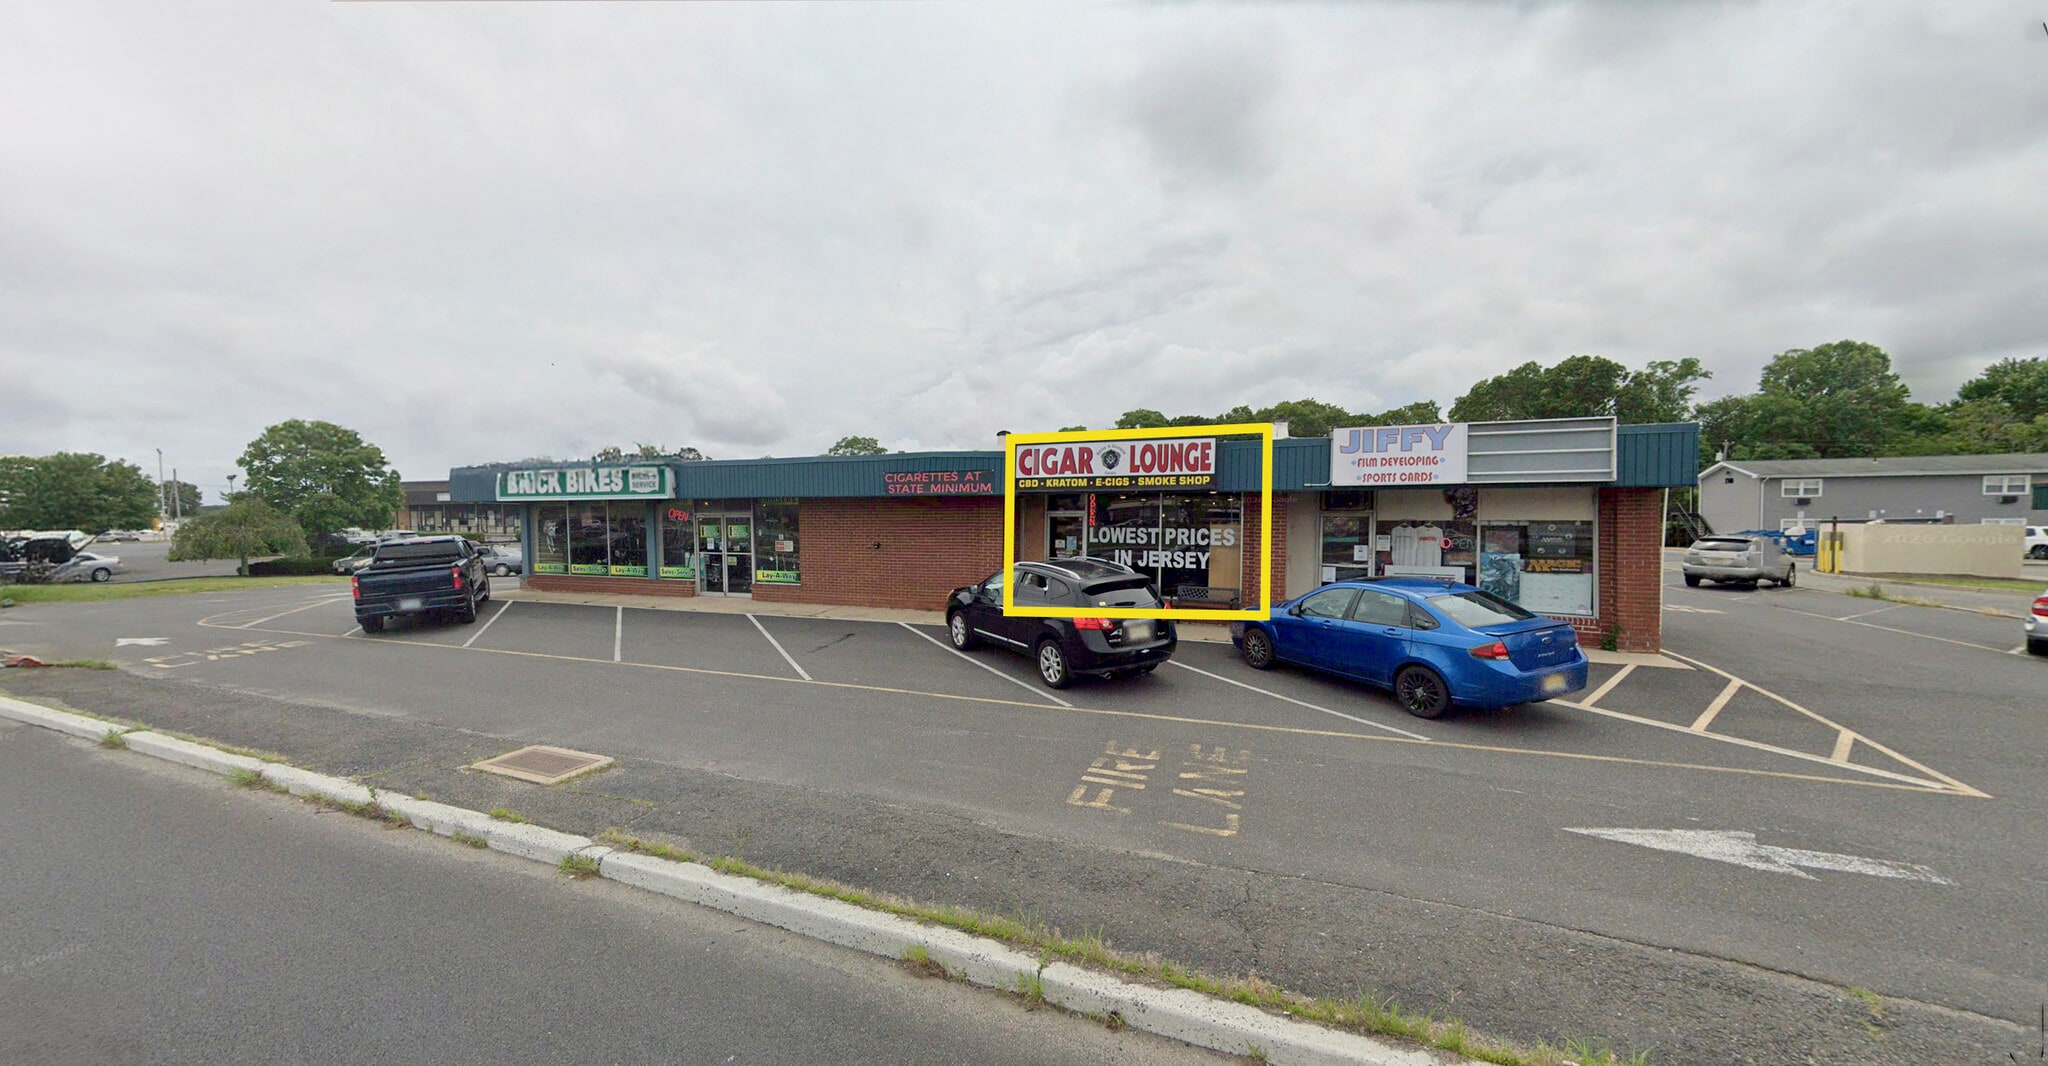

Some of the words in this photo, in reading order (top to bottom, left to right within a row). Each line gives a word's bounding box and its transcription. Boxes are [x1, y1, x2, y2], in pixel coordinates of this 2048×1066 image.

[1340, 426, 1455, 454] JIFFY
[1018, 446, 1094, 476] CIGAR
[1129, 442, 1212, 473] LOUNGE
[1357, 457, 1378, 468] FILM
[1380, 455, 1439, 467] DEVELOPING
[566, 469, 624, 493] BIKES
[884, 472, 959, 483] CIGARETTES
[964, 471, 982, 481] AT
[1018, 479, 1039, 488] CBD
[1046, 478, 1087, 487] KRATOM
[1095, 477, 1130, 487] E-CIGS
[1138, 476, 1177, 486] SMOKE
[1179, 475, 1211, 485] SHOP
[1362, 473, 1397, 483] SPORTS
[1399, 472, 1433, 482] CARDS
[888, 484, 924, 494] STATE
[930, 483, 992, 493] MINIMUM
[668, 508, 689, 521] OPEN
[1089, 527, 1160, 545] LOWEST
[1165, 527, 1235, 547] PRICES
[1114, 550, 1132, 567] IN
[1138, 550, 1211, 569] JERSEY
[1066, 737, 1160, 815] FIRE
